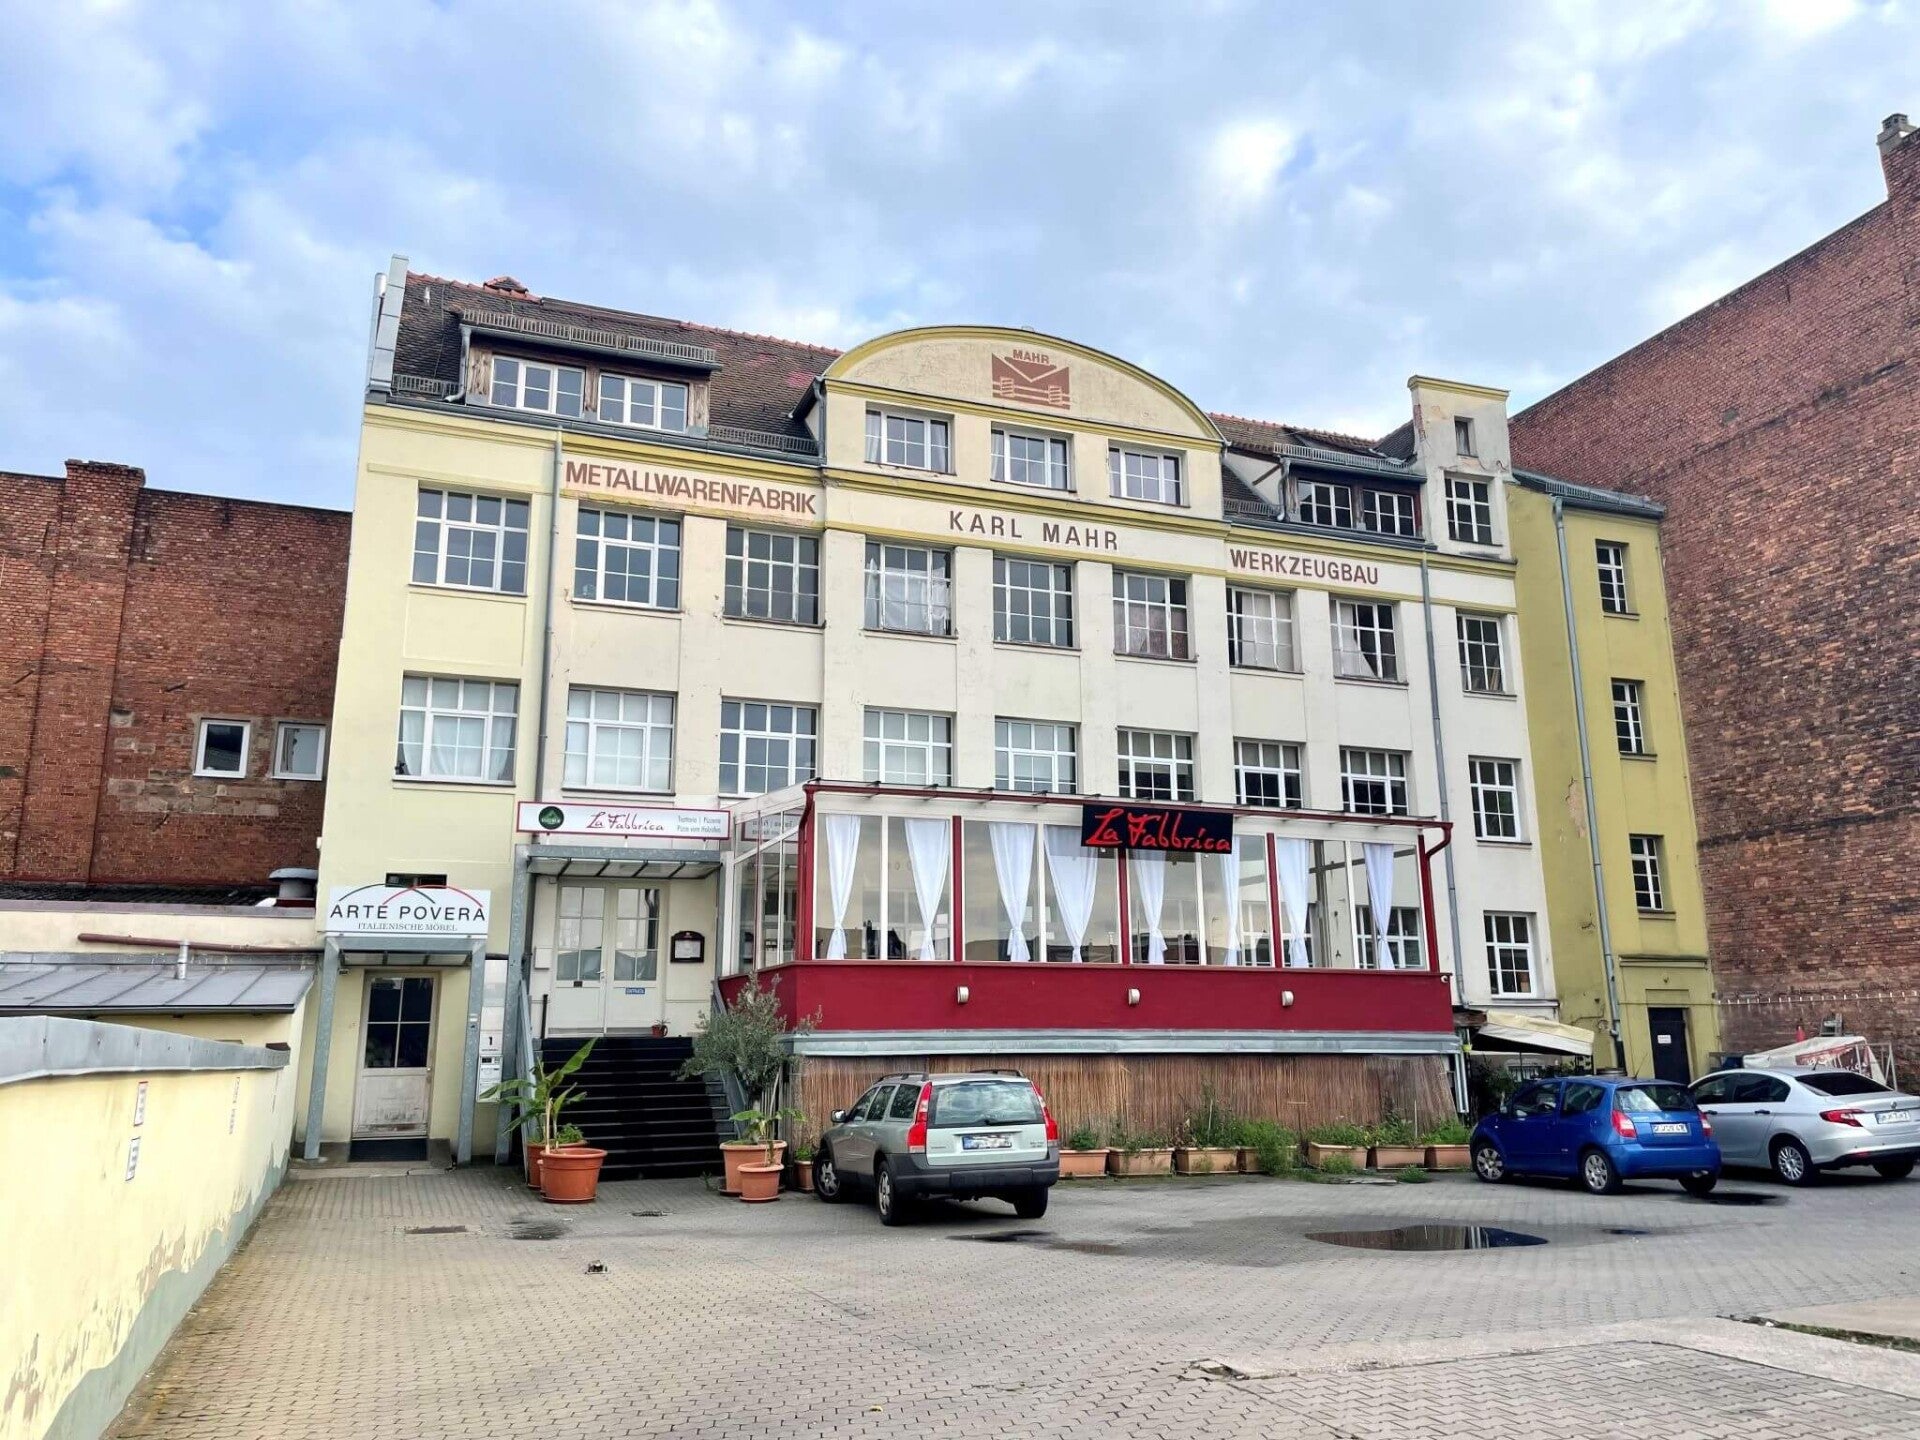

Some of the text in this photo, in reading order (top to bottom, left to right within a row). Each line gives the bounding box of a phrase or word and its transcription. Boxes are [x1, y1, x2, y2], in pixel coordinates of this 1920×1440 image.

[1012, 349, 1050, 364] MAHR
[566, 461, 816, 514] METALLWARENFABRIK
[949, 510, 1118, 550] KARL MAHR
[1230, 549, 1378, 585] WERKZEUGBAU
[586, 811, 664, 830] La Fabbrica
[1085, 808, 1231, 851] La Fabbrica
[330, 905, 485, 922] ARTE POVERA
[358, 922, 458, 932] ITALIENISCHE MÖBEL
[488, 1036, 493, 1045] 1
